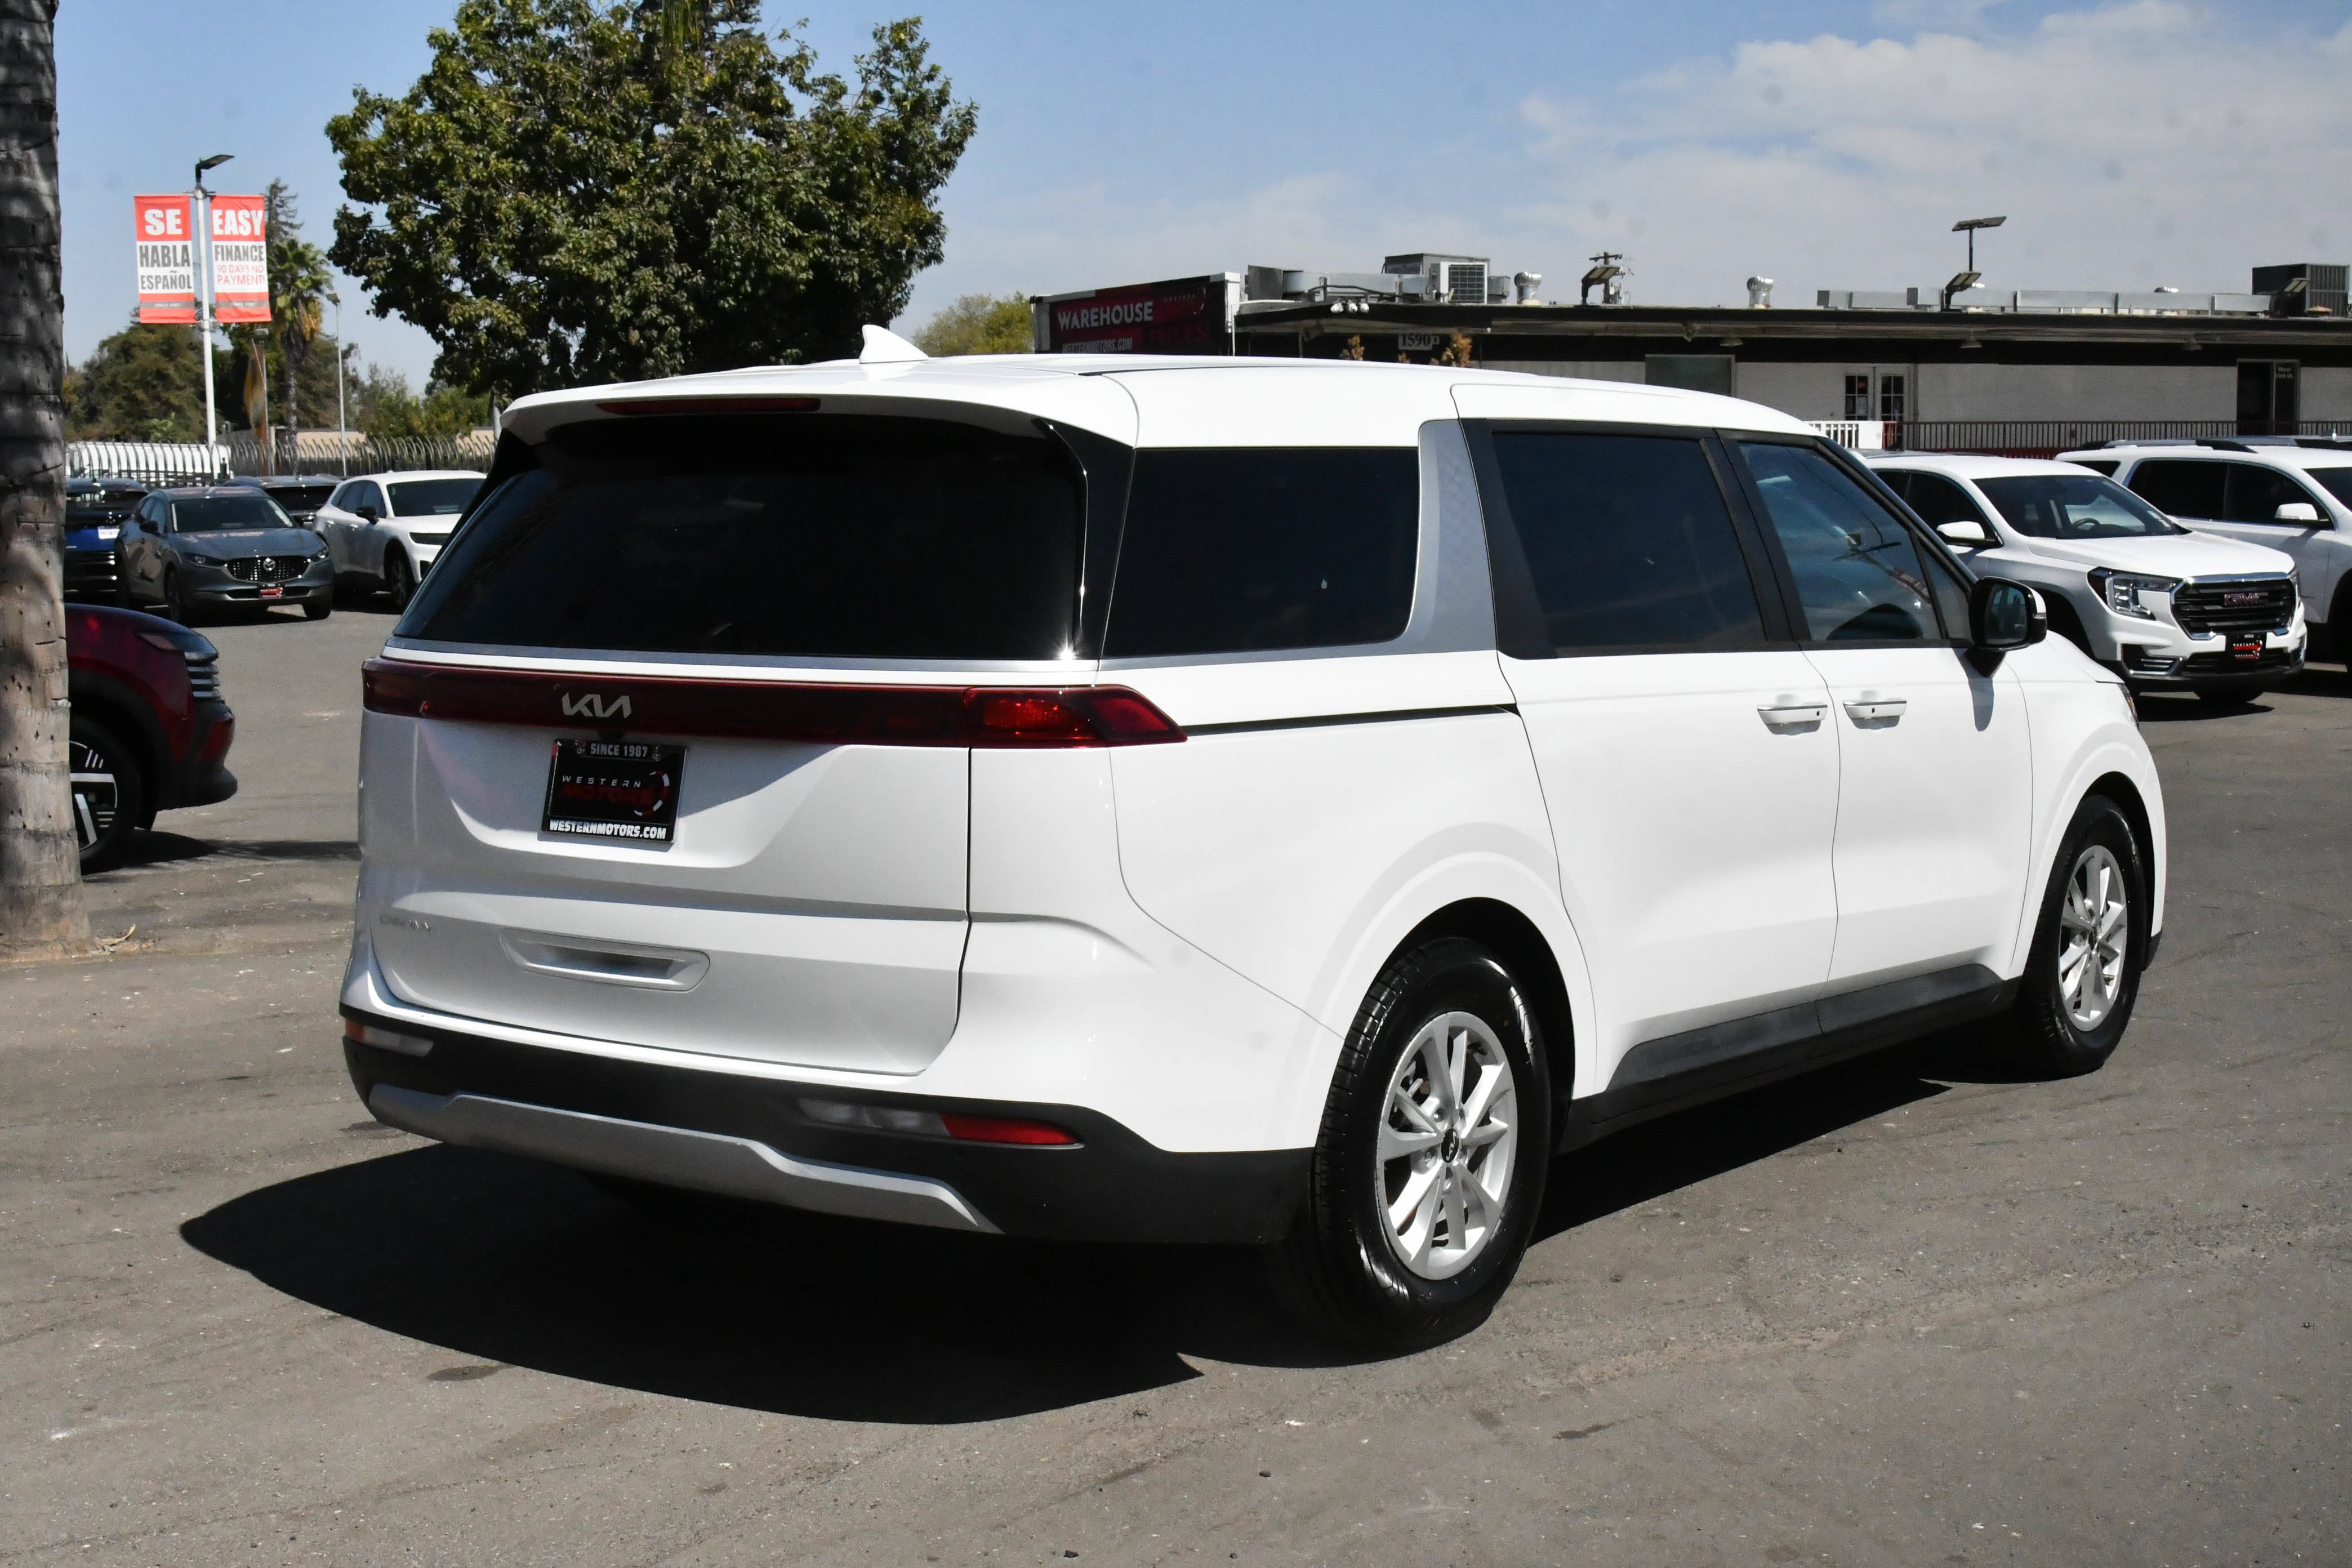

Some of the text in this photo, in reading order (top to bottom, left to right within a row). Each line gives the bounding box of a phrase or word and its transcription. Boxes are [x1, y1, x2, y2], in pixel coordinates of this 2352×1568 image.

[144, 208, 182, 235] SE
[212, 209, 263, 235] EASY
[139, 244, 191, 268] HABLA
[214, 245, 264, 262] FINANCE
[140, 270, 192, 289] ESPAÑOL
[1057, 301, 1153, 332] WAREHOUSE
[562, 692, 632, 719] KIA
[590, 743, 648, 758] SINCE 1987
[562, 775, 642, 788] WESTERN
[550, 819, 667, 839] WESTERNMOTORS.COM
